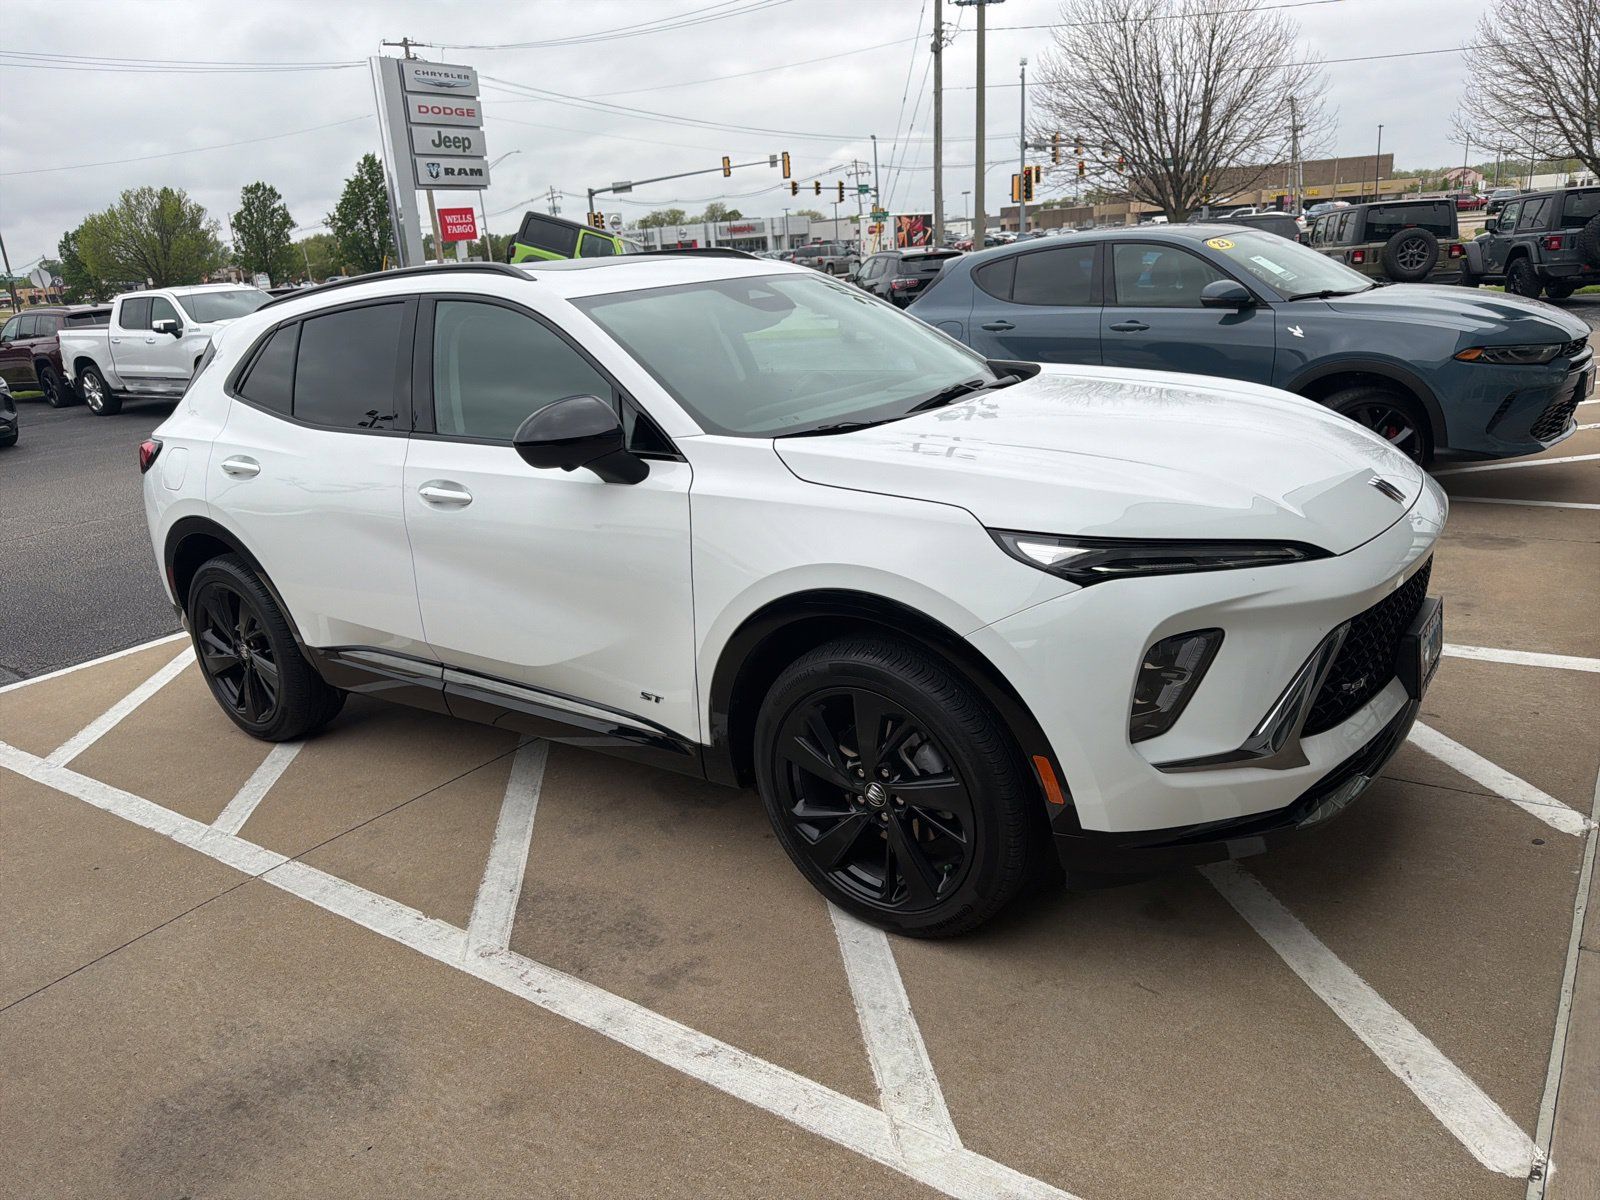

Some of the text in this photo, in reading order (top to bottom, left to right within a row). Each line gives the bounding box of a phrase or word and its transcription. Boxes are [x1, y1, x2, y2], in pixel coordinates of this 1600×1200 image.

[414, 69, 470, 80] CHRYSLER
[417, 105, 476, 117] DODGE
[431, 130, 472, 153] Jeep
[444, 167, 483, 177] RAM
[445, 214, 472, 223] WELLS
[447, 224, 474, 234] FARGO
[640, 691, 664, 704] ST
